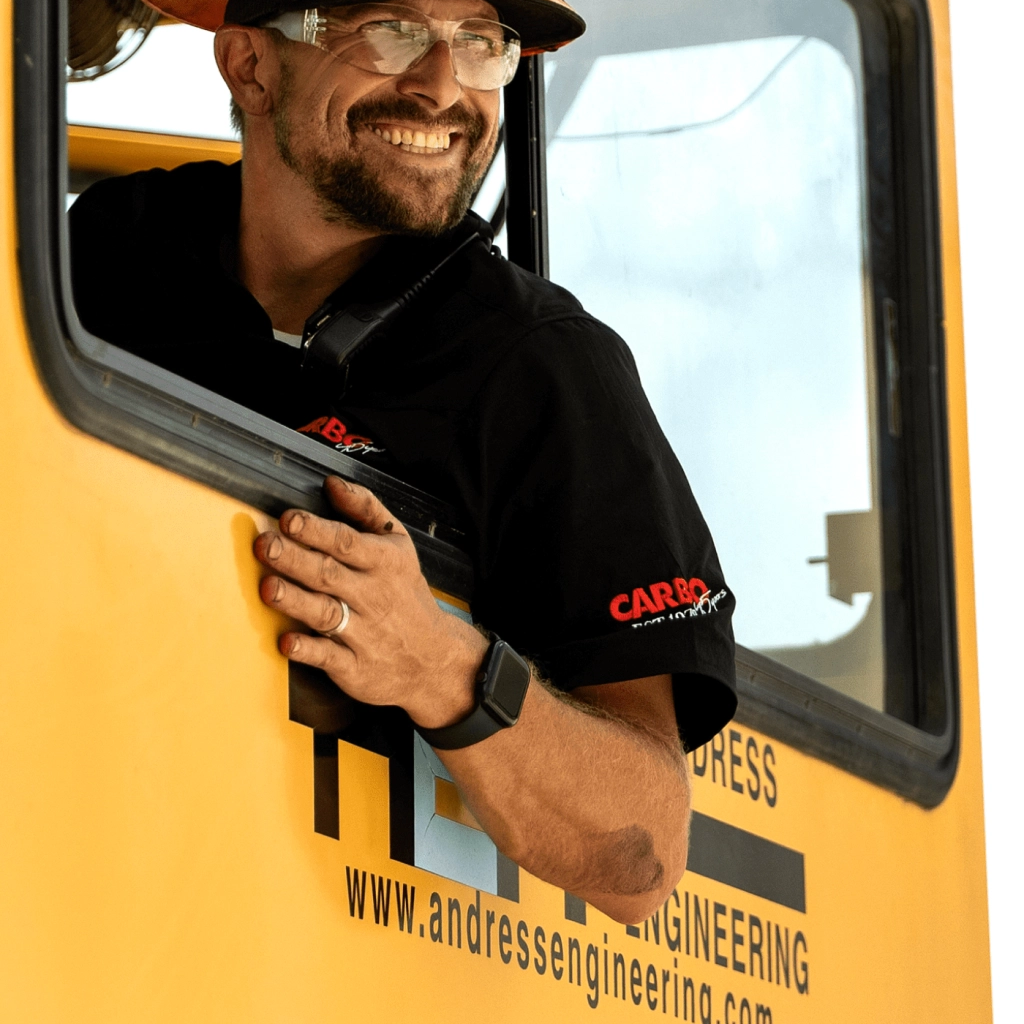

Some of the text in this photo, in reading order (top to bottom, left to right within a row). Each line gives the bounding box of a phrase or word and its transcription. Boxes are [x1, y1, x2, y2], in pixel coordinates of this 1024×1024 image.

[609, 577, 710, 622] CARBO
[693, 730, 777, 808] RESS
[626, 888, 809, 996] GINEERING
